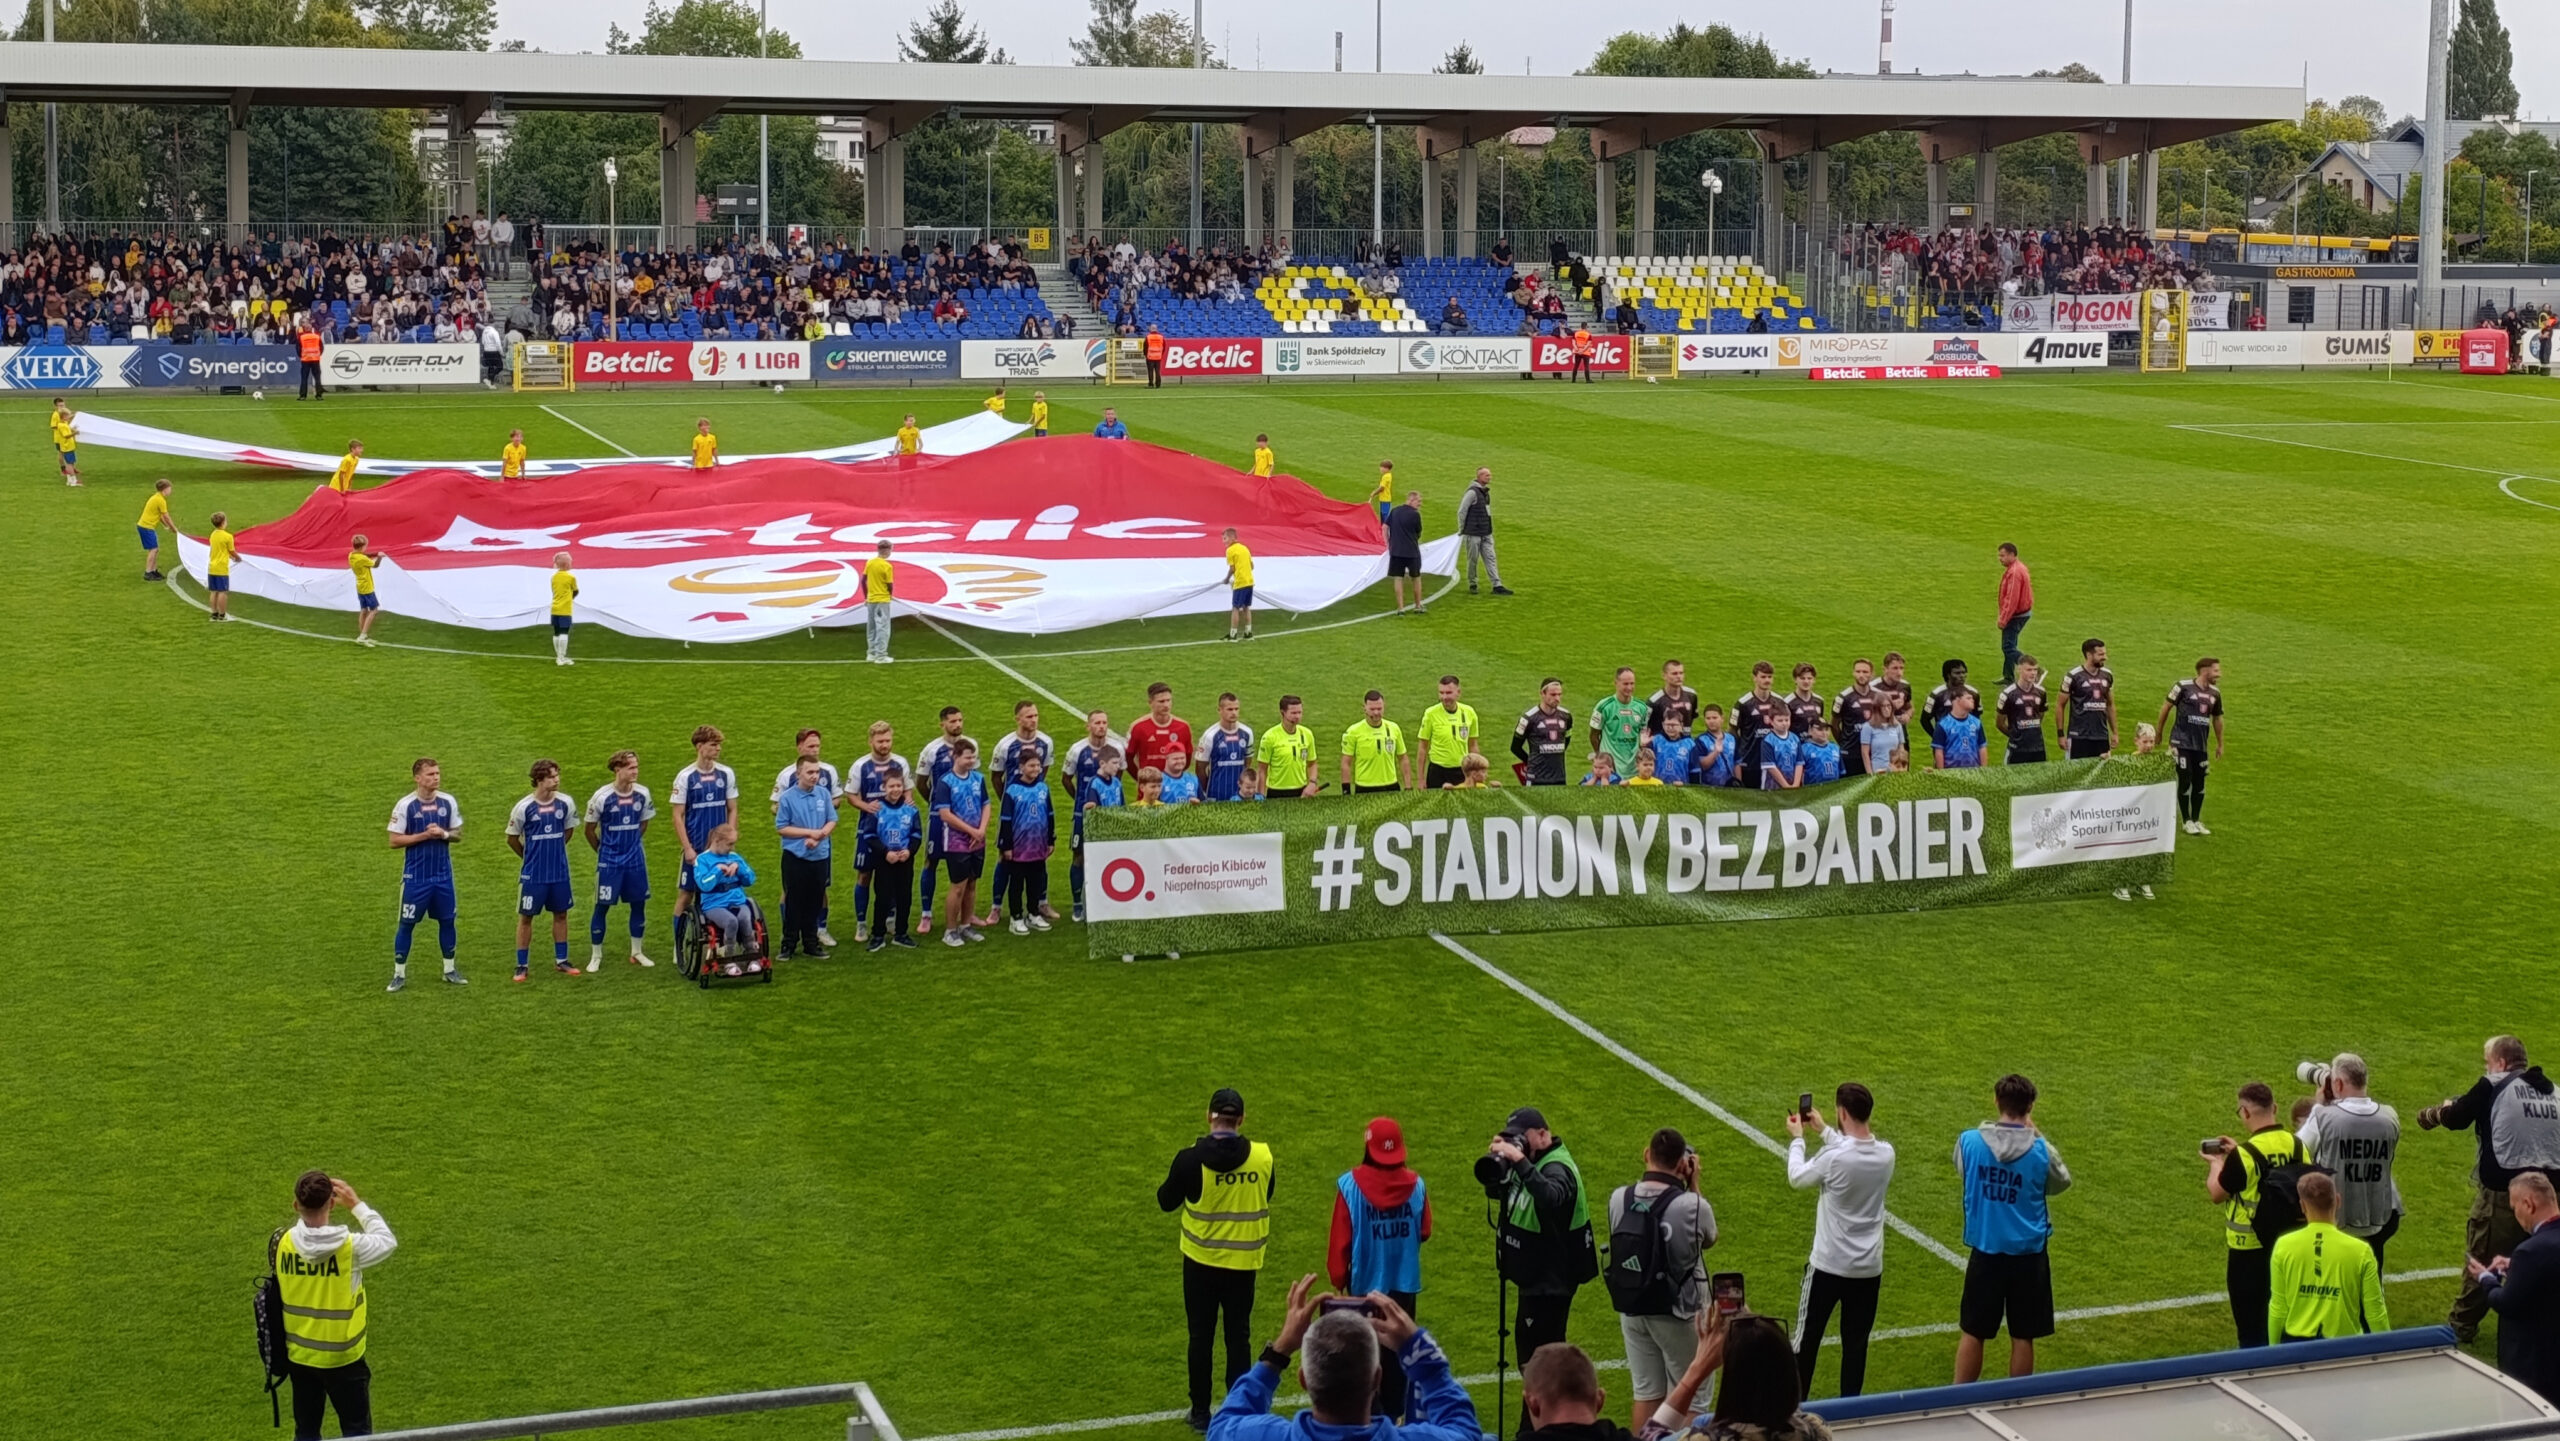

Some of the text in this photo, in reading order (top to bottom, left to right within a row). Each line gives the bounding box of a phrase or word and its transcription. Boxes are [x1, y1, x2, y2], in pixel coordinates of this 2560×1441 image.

[2275, 267, 2356, 278] GASTRONOMIA
[2057, 296, 2133, 322] POGOŃ
[1306, 346, 1386, 357] Bank Spółdzielczy
[1702, 346, 1768, 359] SUZUKI
[1942, 343, 1972, 352] DACHY
[2222, 344, 2245, 353] NOWE
[2247, 344, 2275, 353] WIDOKI
[2326, 332, 2391, 356] GUMIŚ
[584, 350, 674, 374] Betclic
[736, 352, 800, 369] 1 LIGA
[995, 352, 1039, 367] DEKA
[1165, 344, 1253, 368] Betclic
[1440, 348, 1523, 365] KONTAKT
[1539, 341, 1624, 366] Beclic
[1933, 353, 1978, 361] ROSBUDEX
[19, 357, 87, 377] VEKA
[188, 357, 288, 380] Synergico
[1008, 367, 1039, 376] TRANS
[1823, 367, 1866, 379] Betclic
[1885, 366, 1928, 378] Betclic
[1947, 365, 1990, 377] Betclic
[414, 505, 1206, 552] Betclic
[2070, 805, 2141, 822] Ministerstwo
[2071, 823, 2108, 839] Sportu
[2116, 815, 2160, 834] Turystyki
[887, 829, 901, 844] 12
[1072, 834, 1080, 848] 9
[856, 852, 866, 867] 11
[1311, 797, 1988, 911] #STADIONY BEZ BARIER
[1163, 858, 1267, 876] Federacja Kibiców
[599, 885, 612, 900] 53
[1164, 874, 1268, 894] Niepełnosprawnych
[402, 903, 416, 919] 52
[522, 895, 533, 911] 18
[2522, 1102, 2558, 1120] KLUB
[2339, 1139, 2389, 1161] MEDIA
[1215, 1171, 1259, 1187] FOTO
[2344, 1163, 2382, 1183] KLUB
[1982, 1182, 2018, 1205] KLUB
[1372, 1222, 1411, 1241] KLUB
[2235, 1235, 2247, 1246] 27
